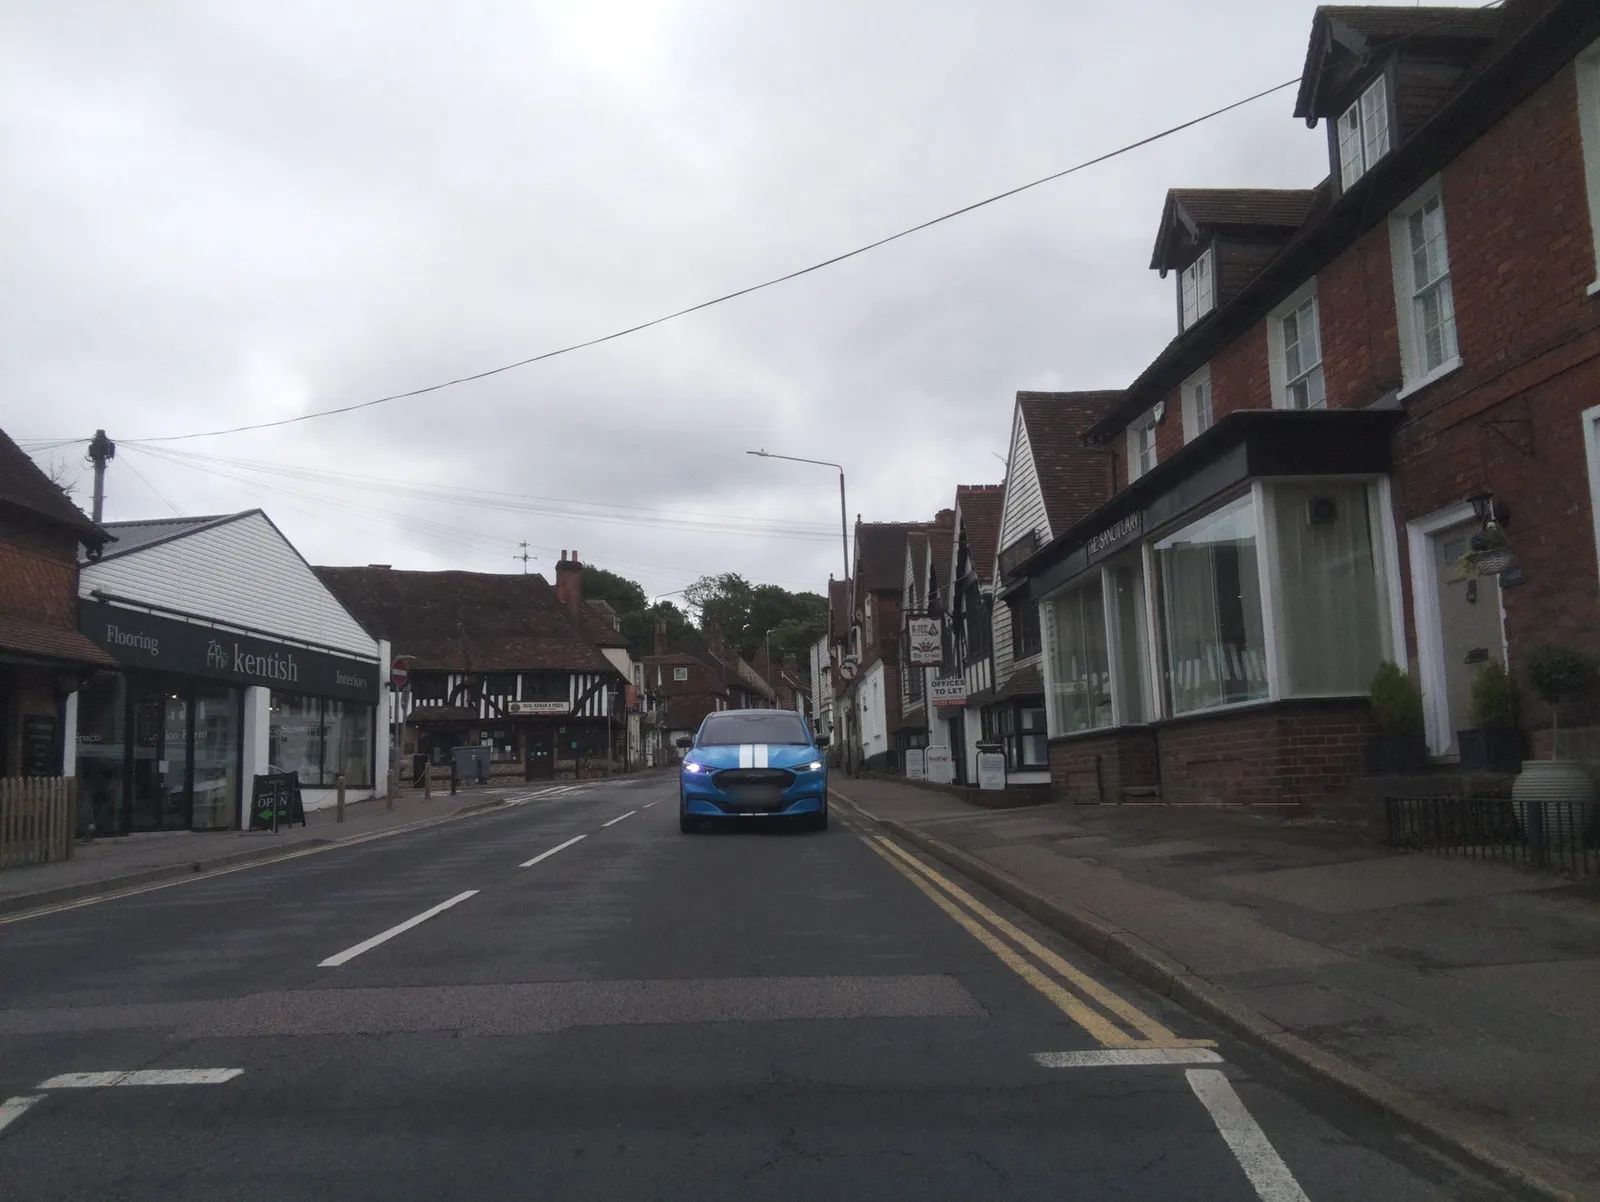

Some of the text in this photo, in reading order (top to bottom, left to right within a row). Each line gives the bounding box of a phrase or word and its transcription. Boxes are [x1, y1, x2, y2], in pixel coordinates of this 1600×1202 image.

[105, 624, 159, 656] Flooring
[232, 643, 298, 682] kentish
[336, 670, 368, 690] Interiors
[931, 679, 965, 687] OFFICES
[257, 796, 288, 808] OPN
